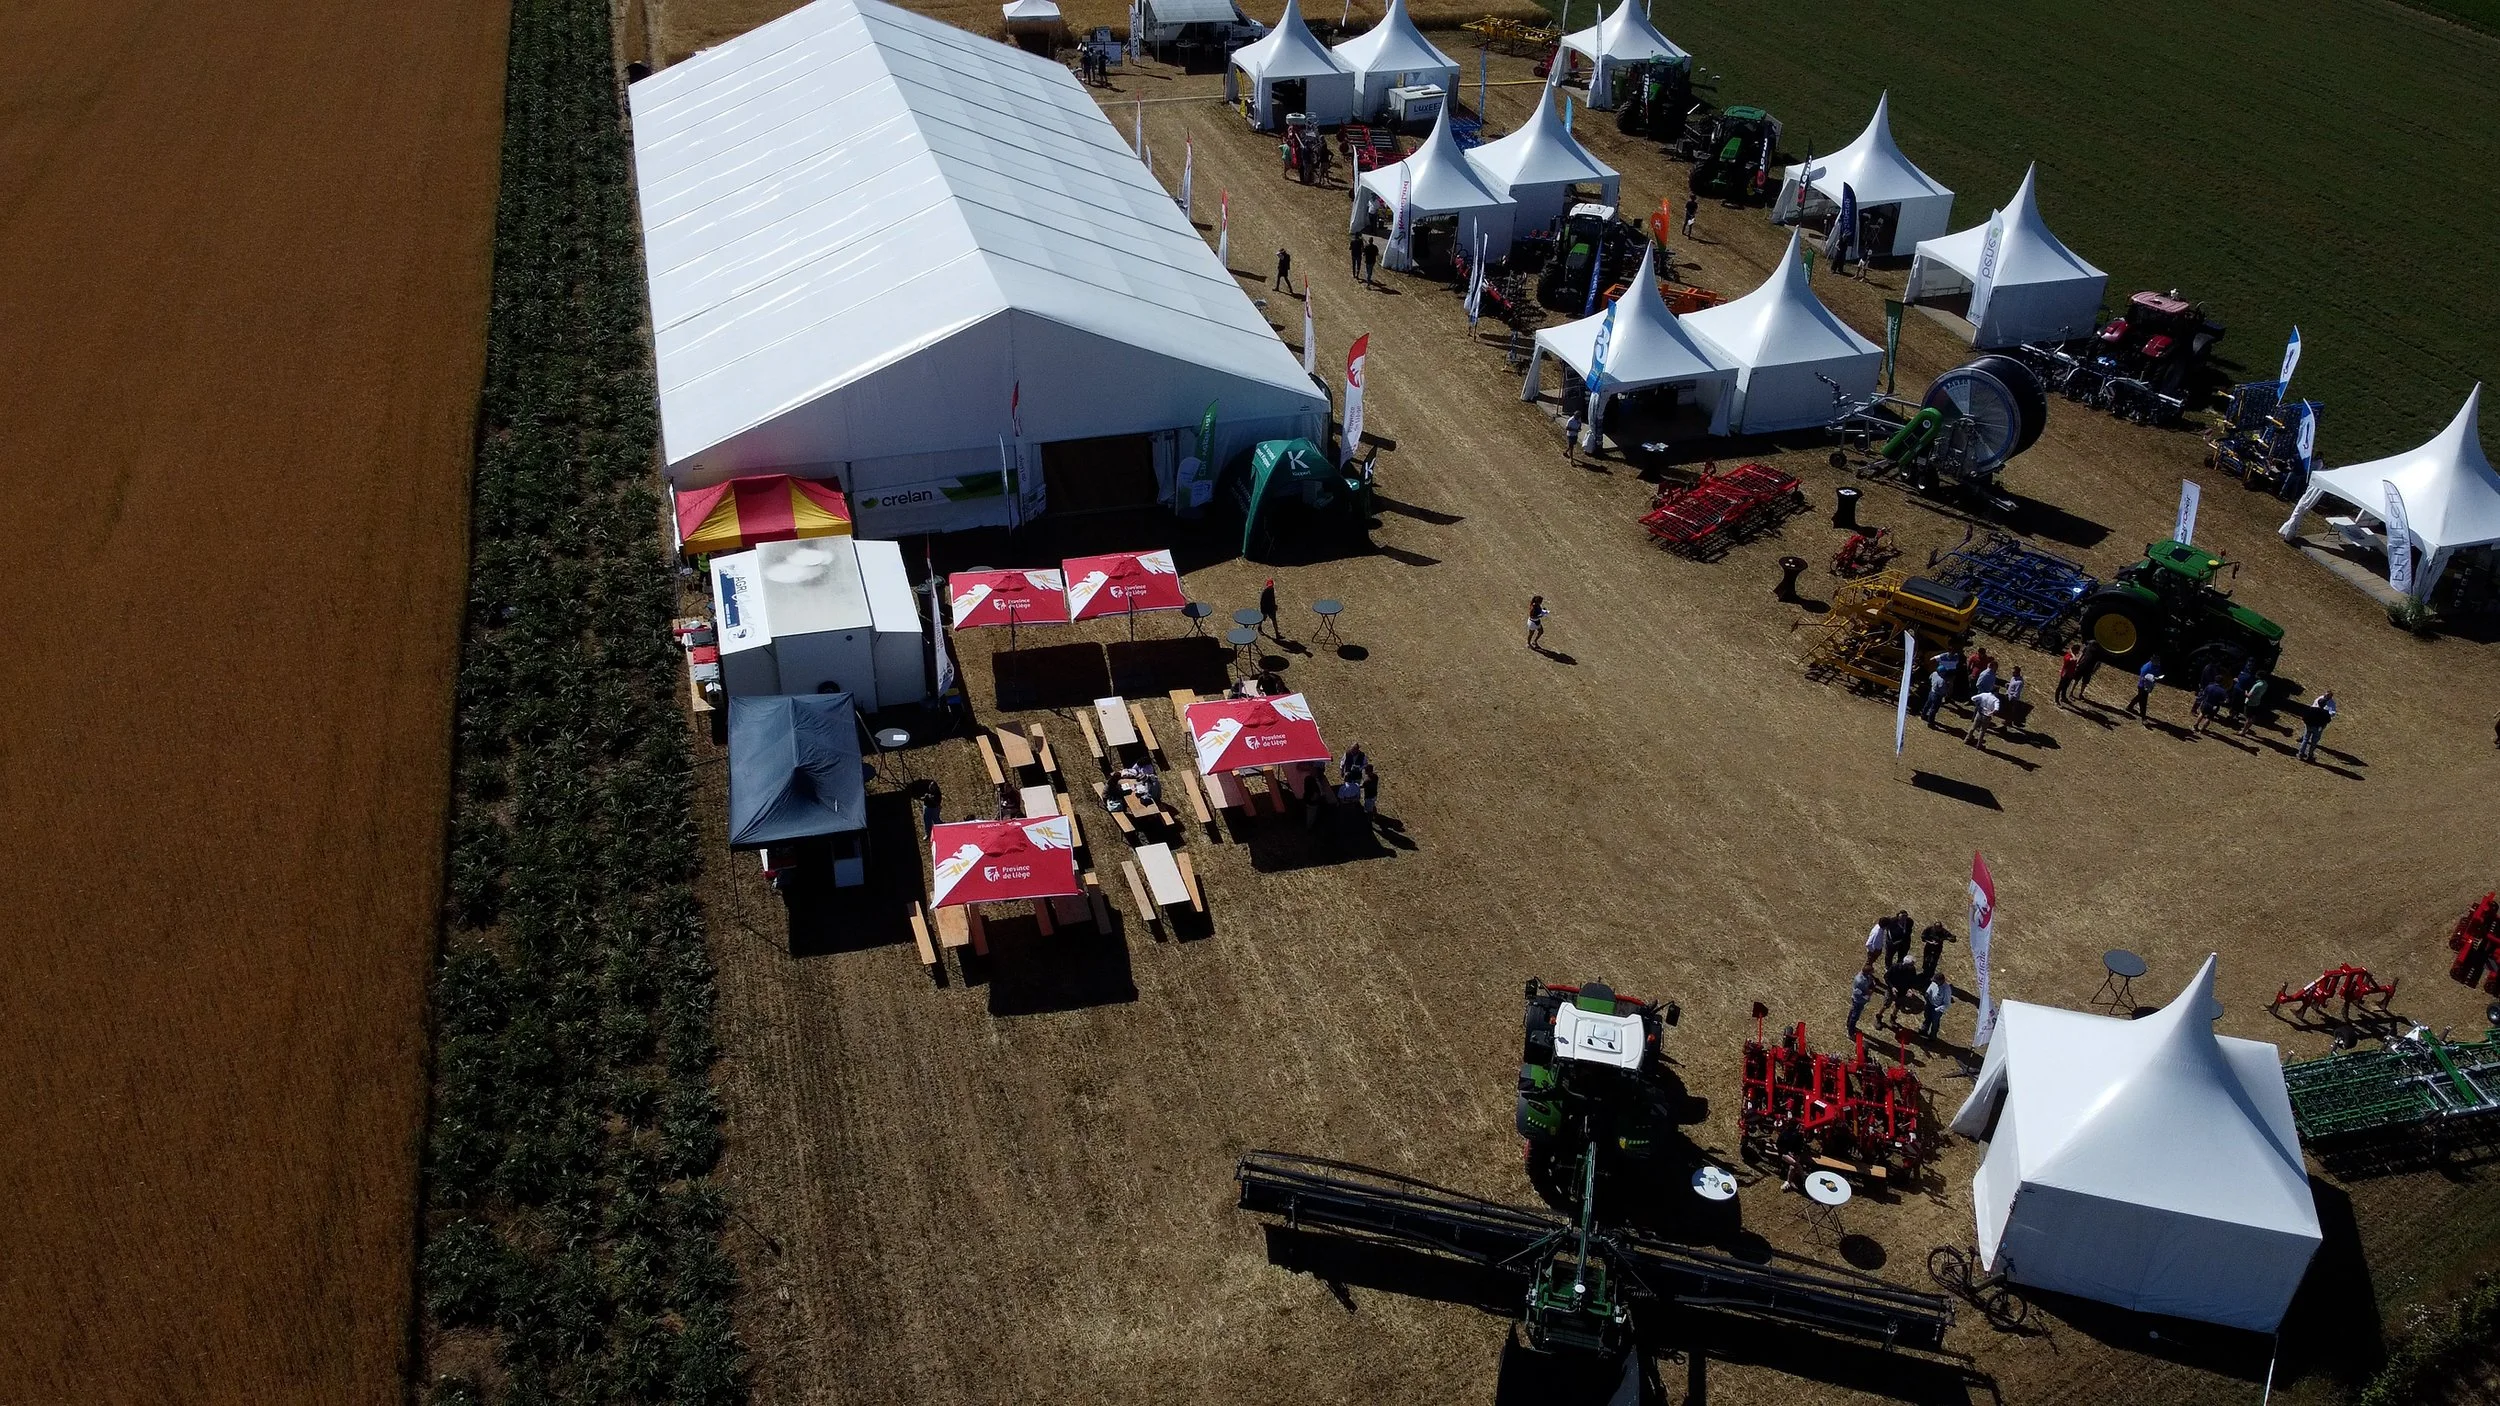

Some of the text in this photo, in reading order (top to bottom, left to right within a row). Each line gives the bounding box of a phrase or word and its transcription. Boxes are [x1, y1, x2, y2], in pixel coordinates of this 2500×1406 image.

[881, 489, 933, 507] crelan
[735, 576, 748, 594] AGRI
[1261, 733, 1286, 742] Province
[1271, 739, 1288, 747] Liège
[1002, 864, 1030, 872] Province
[1002, 871, 1031, 880] de Liège
